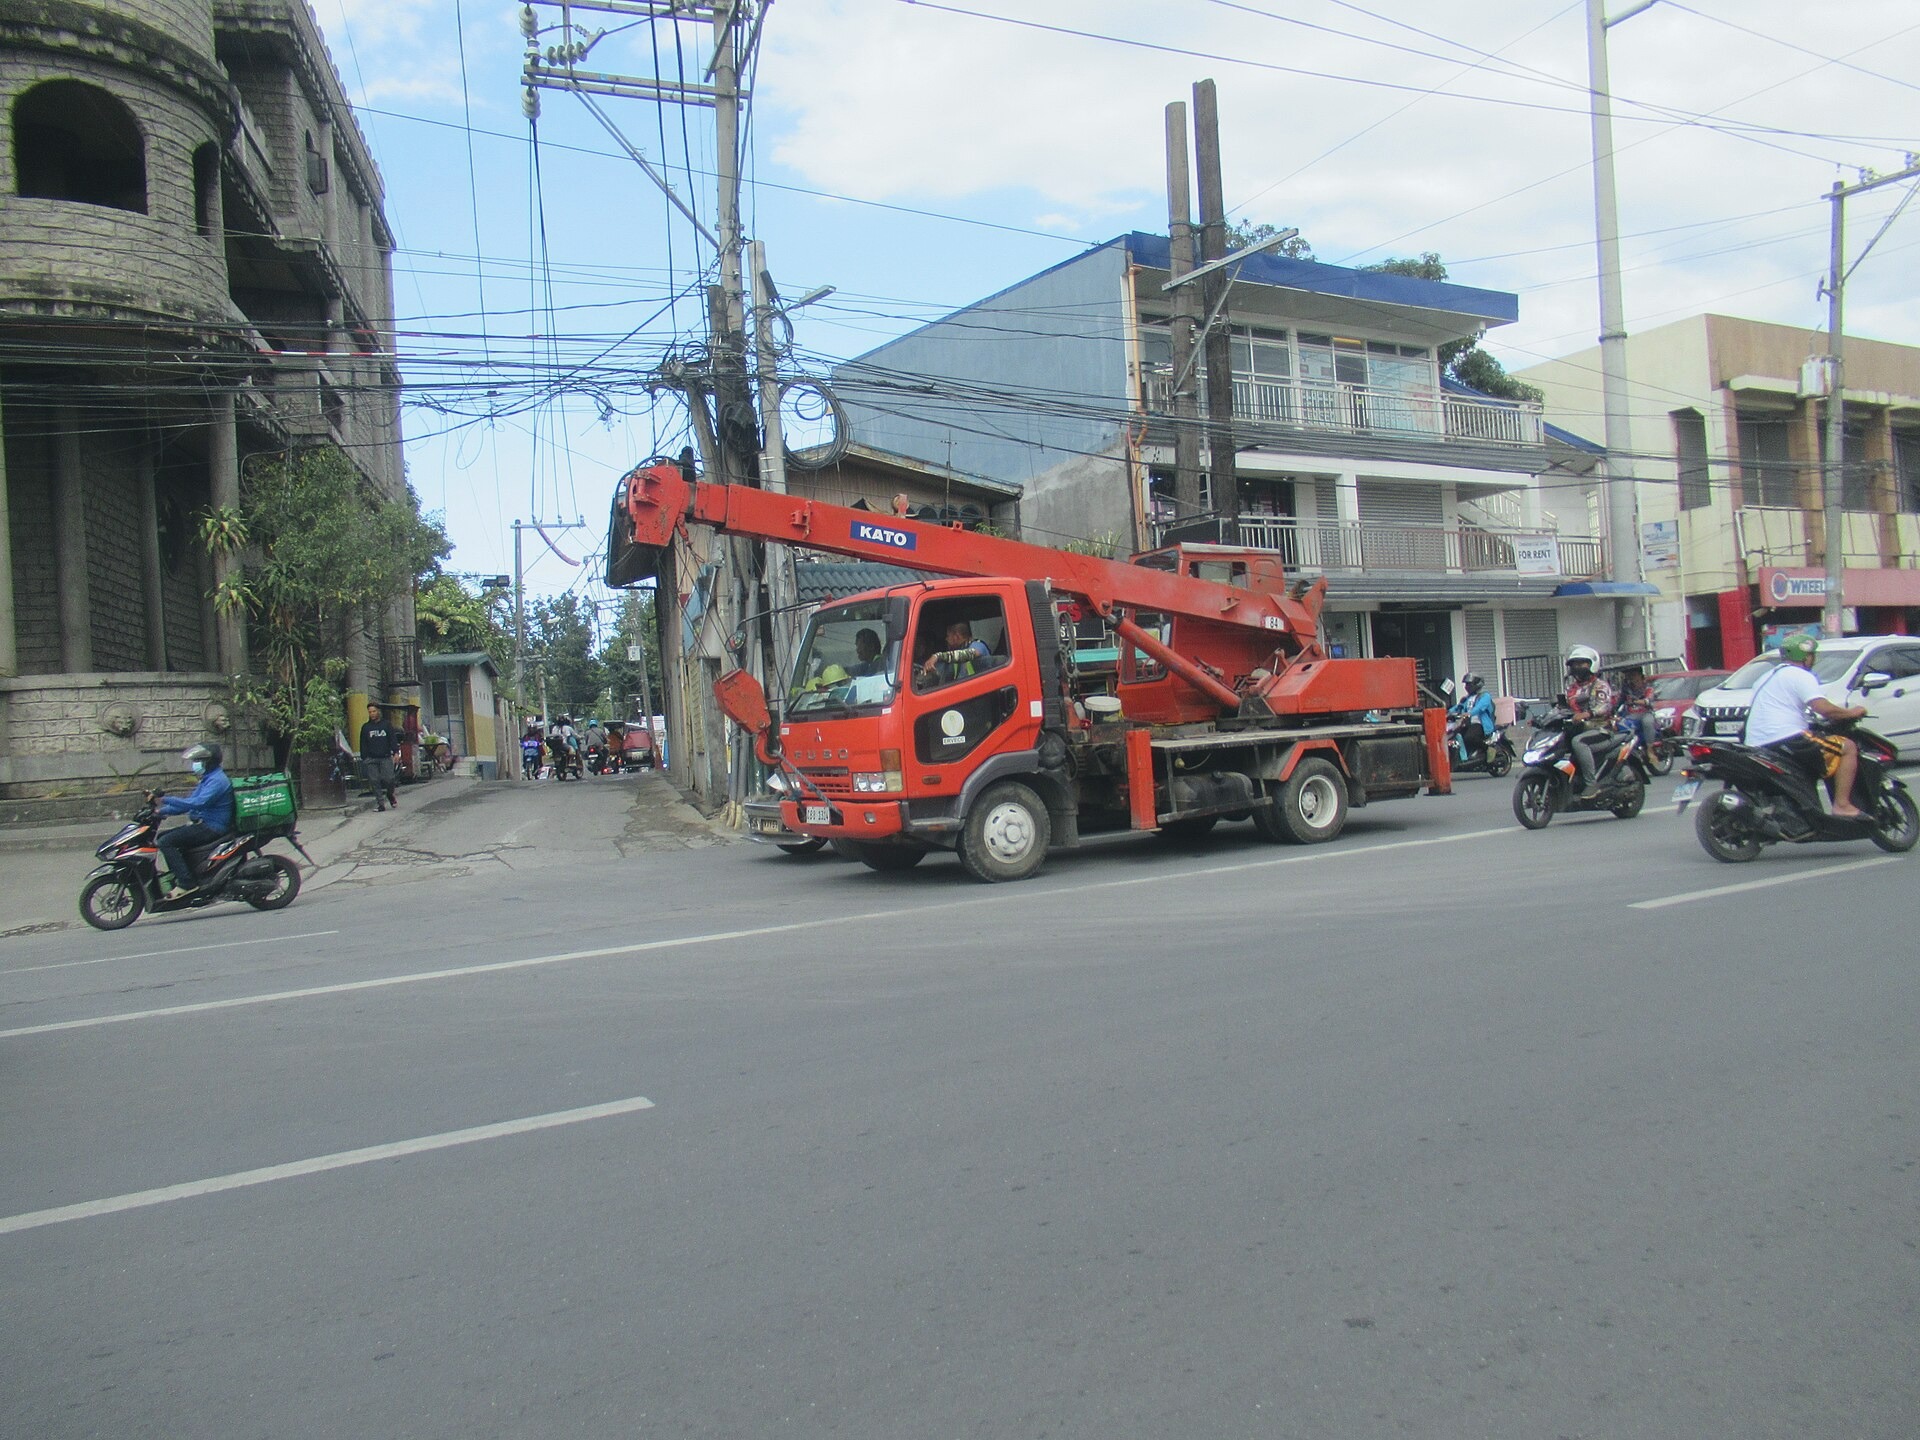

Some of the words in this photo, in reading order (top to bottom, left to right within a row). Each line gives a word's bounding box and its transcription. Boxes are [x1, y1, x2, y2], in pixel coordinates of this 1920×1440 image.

[860, 525, 907, 546] KATO
[1518, 550, 1532, 559] FOR
[1533, 549, 1550, 559] RENT
[1791, 579, 1825, 594] WHEEL
[1269, 616, 1279, 629] 84
[369, 729, 387, 738] FILA
[794, 748, 849, 760] FUSO
